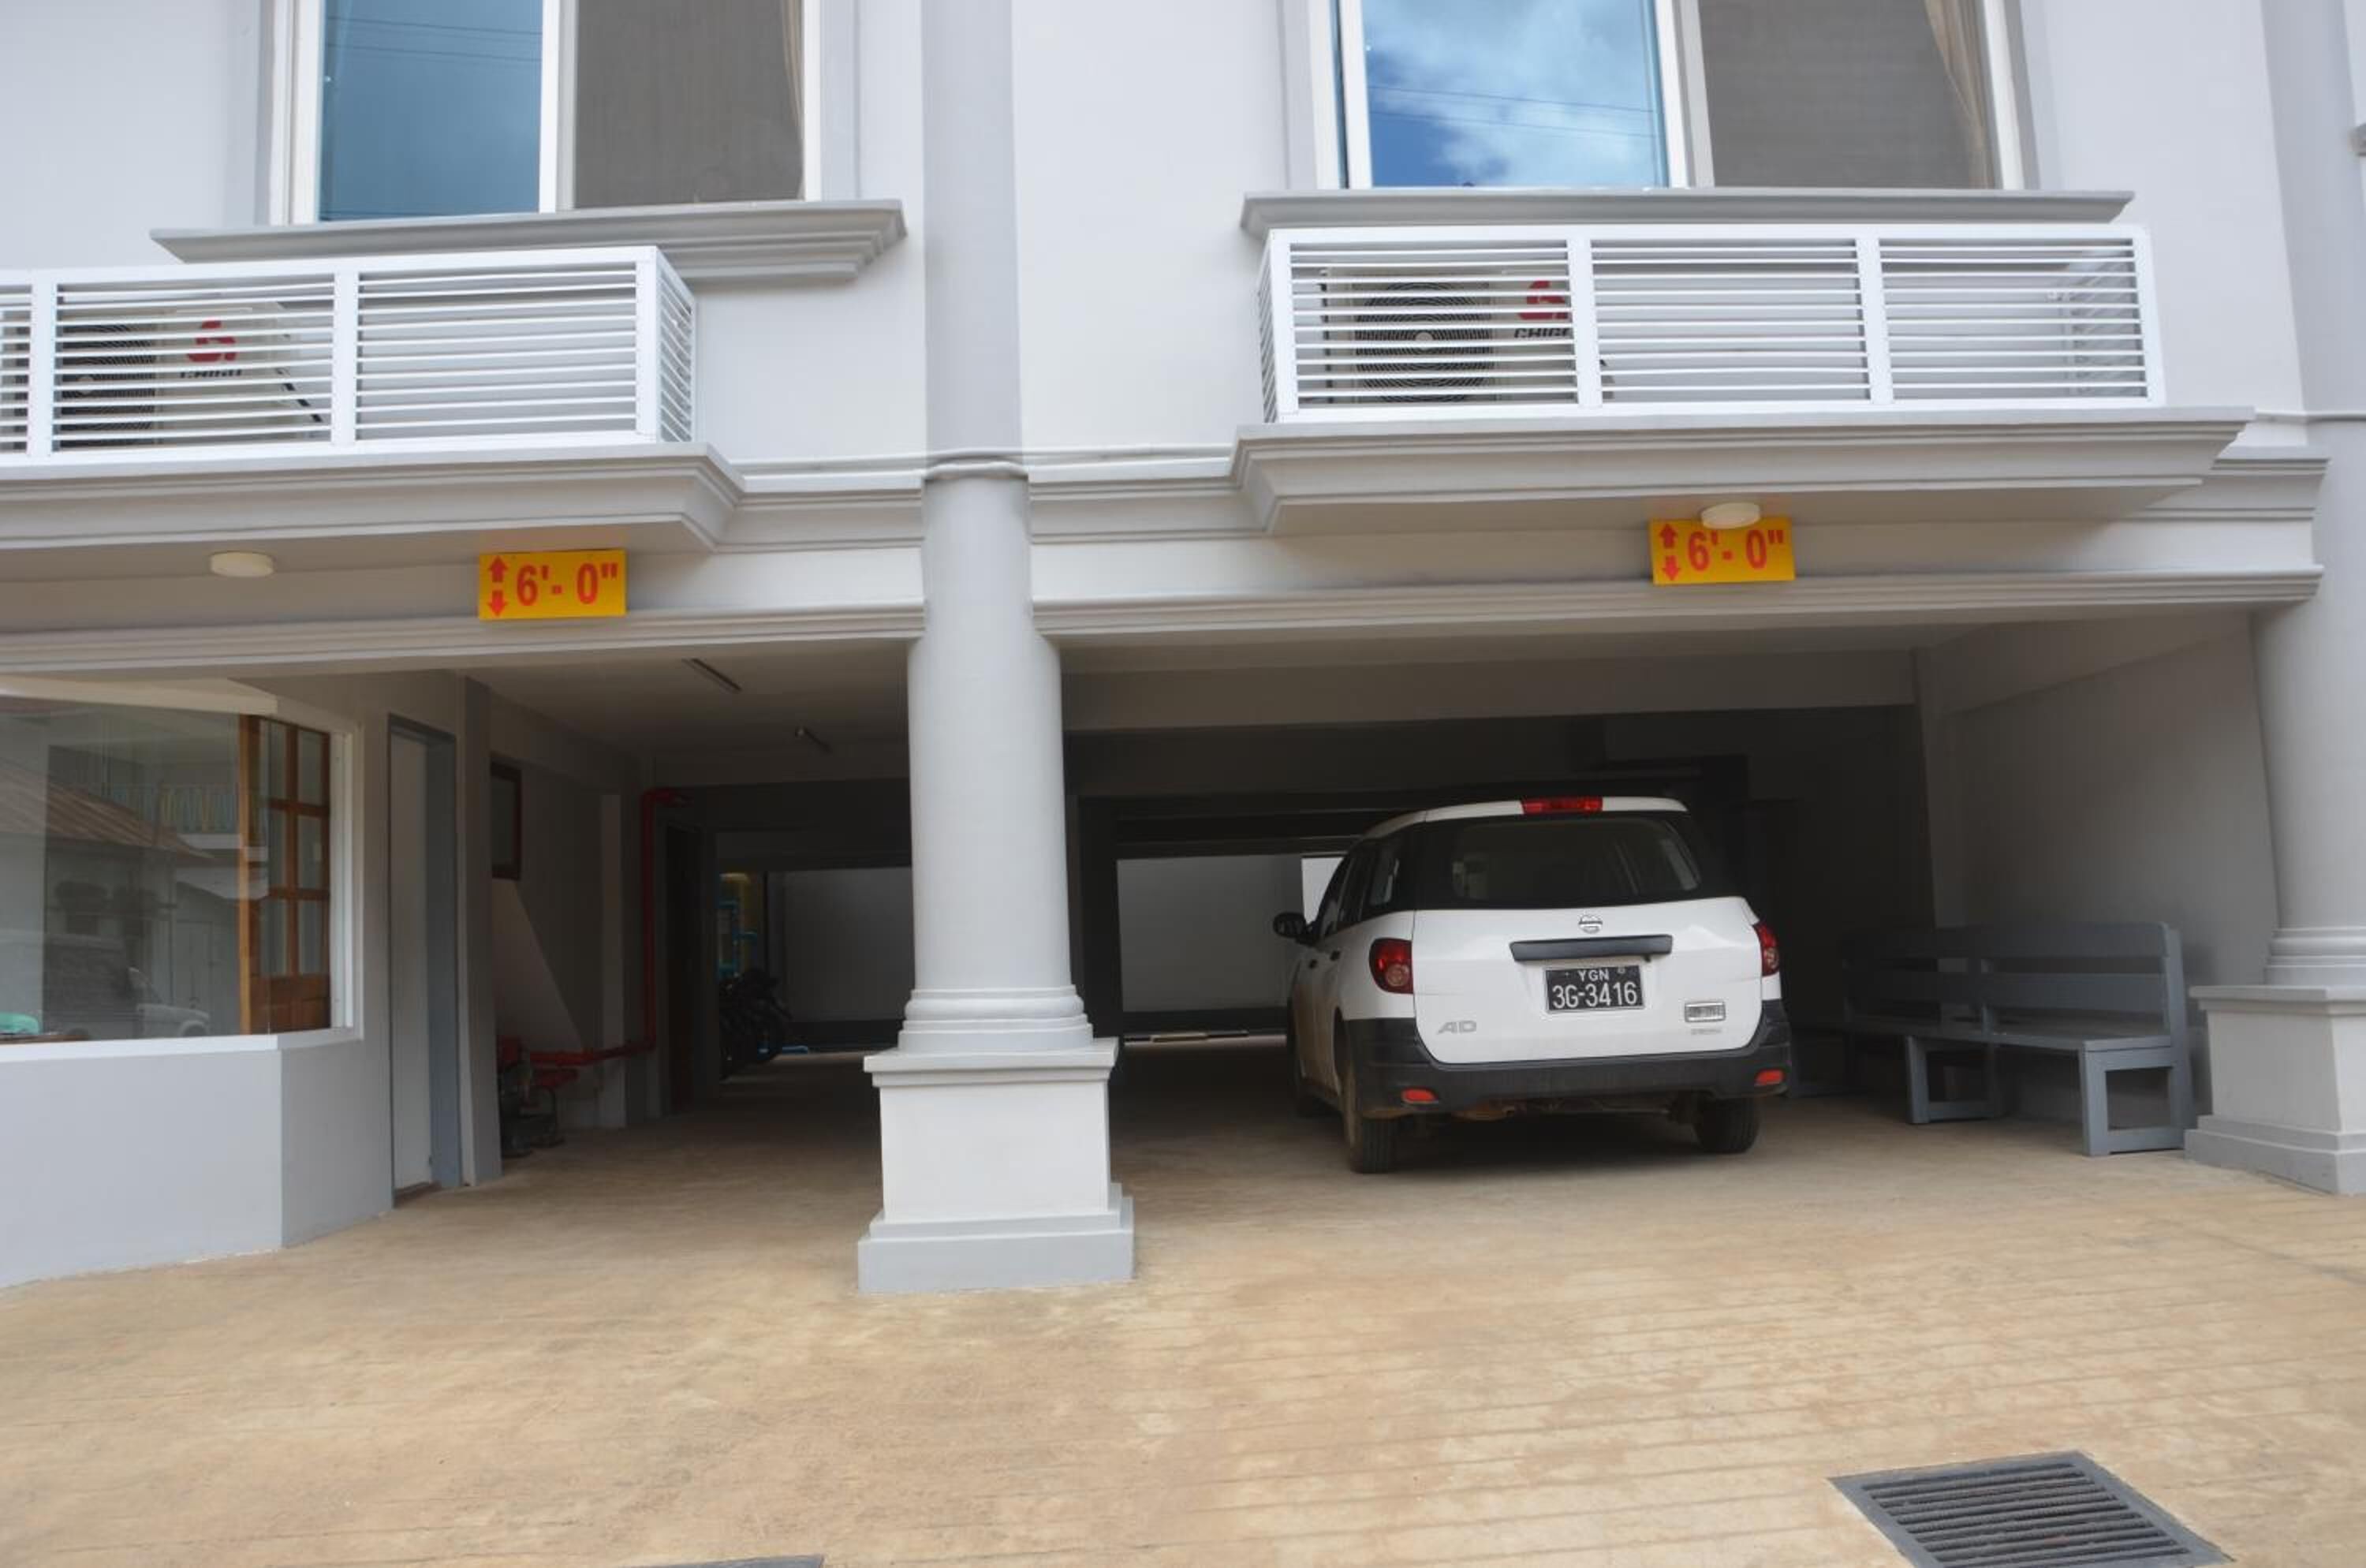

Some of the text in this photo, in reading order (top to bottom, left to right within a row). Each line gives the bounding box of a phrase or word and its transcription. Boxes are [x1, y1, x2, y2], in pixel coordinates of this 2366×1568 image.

[1578, 968, 1610, 982] YGN
[1552, 981, 1637, 1009] 3G-3416
[1437, 1020, 1477, 1034] AD
